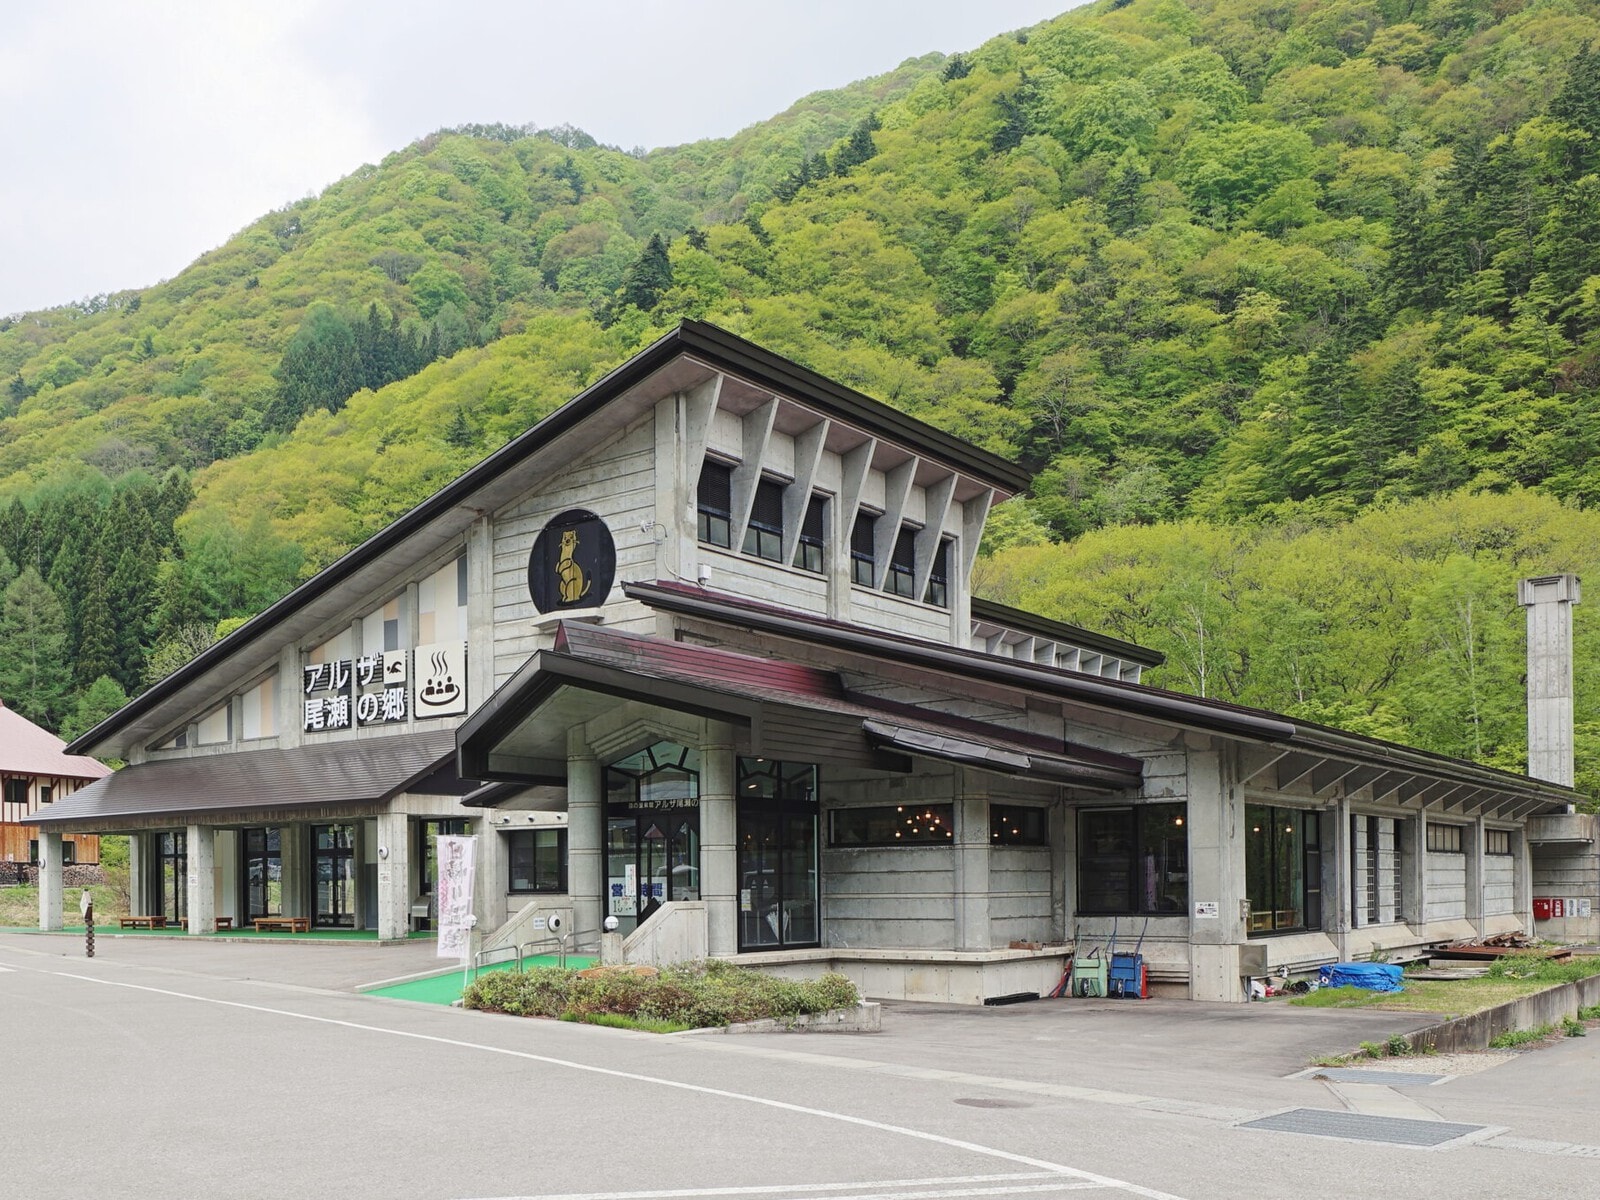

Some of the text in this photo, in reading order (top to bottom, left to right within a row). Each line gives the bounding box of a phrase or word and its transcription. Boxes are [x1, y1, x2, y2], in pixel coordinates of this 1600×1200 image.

[304, 651, 384, 694] アルザ
[304, 687, 405, 730] 尾瀬の郷
